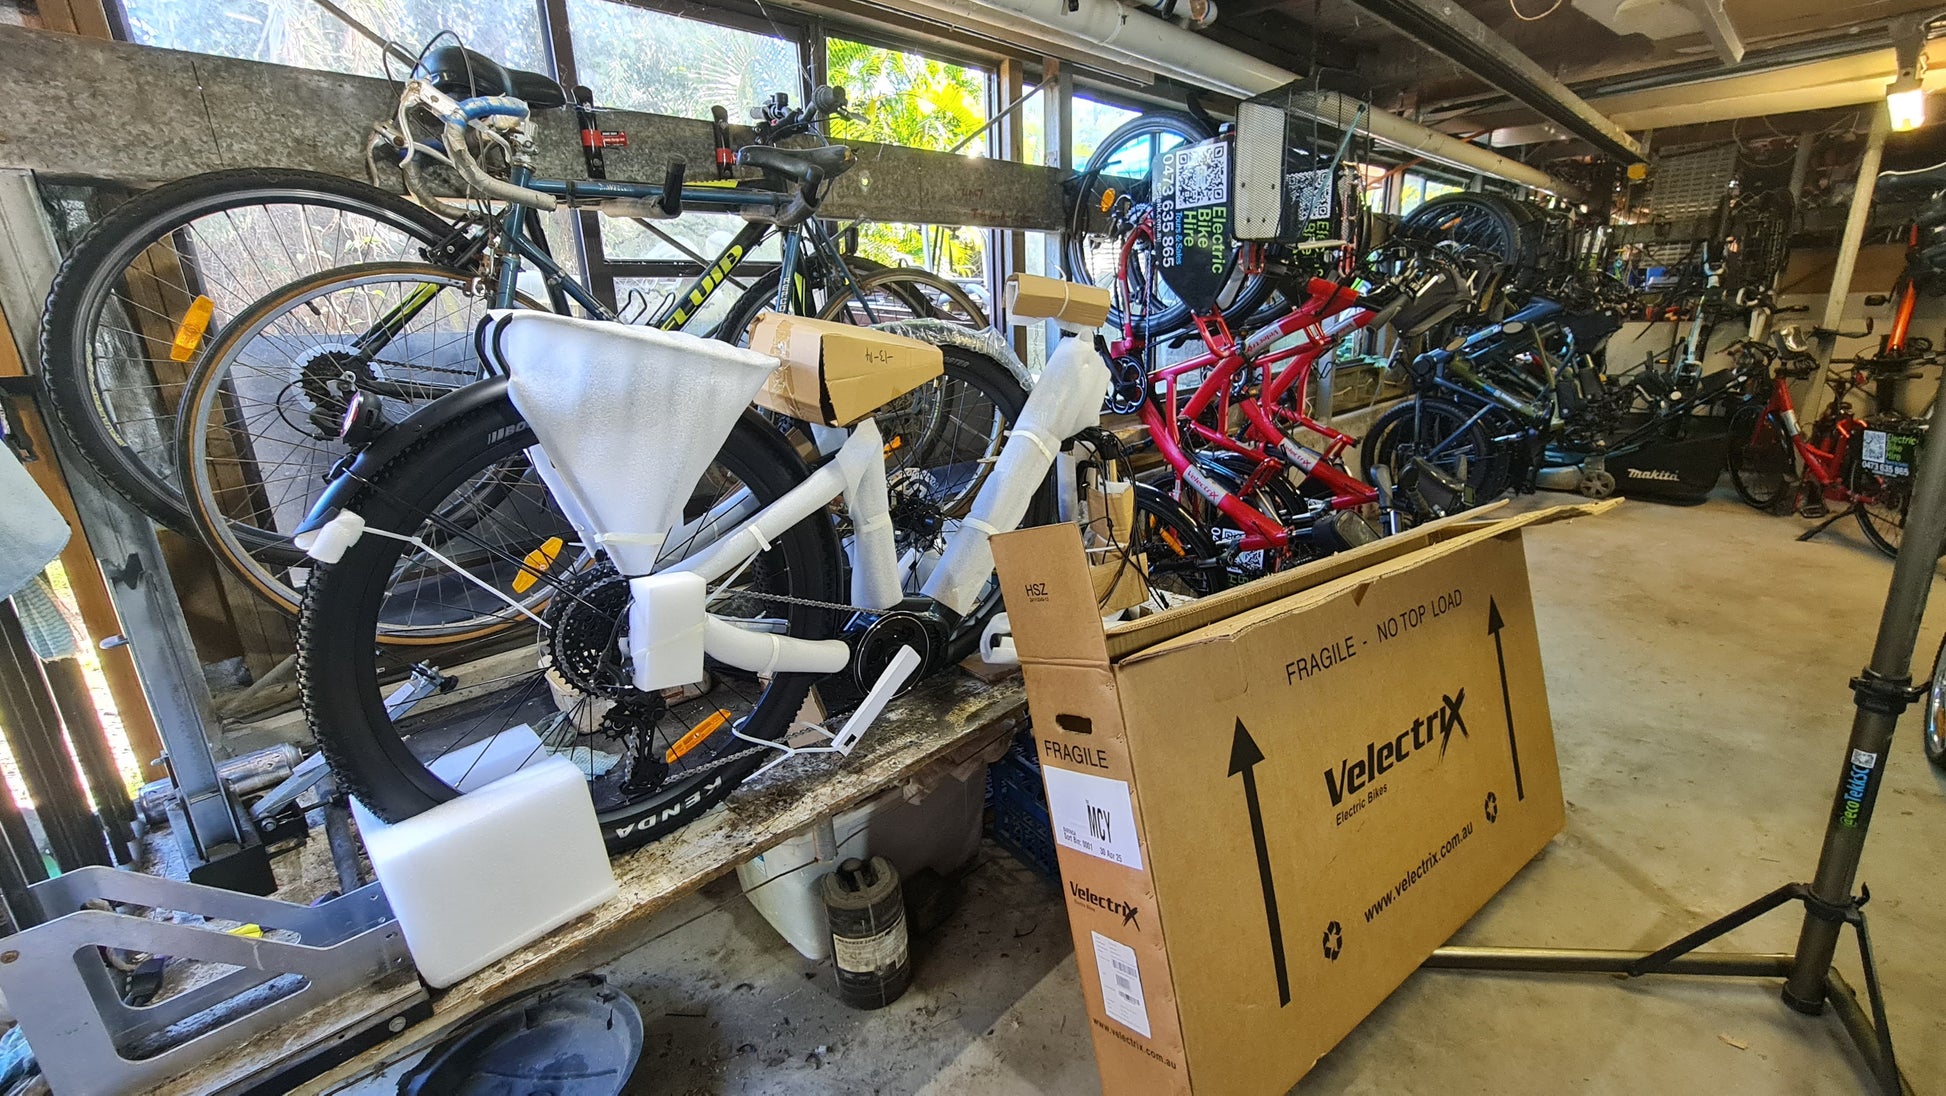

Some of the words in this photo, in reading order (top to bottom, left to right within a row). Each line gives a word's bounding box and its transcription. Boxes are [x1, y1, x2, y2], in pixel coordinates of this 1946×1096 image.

[1162, 153, 1174, 196] 0473
[1162, 200, 1174, 232] 635
[1175, 211, 1183, 233] Tours
[1183, 210, 1197, 247] Hire
[1197, 208, 1212, 248] Bike
[1162, 236, 1175, 268] 865
[1175, 242, 1183, 265] Sales
[1176, 234, 1183, 242] &
[1212, 206, 1227, 274] Electric
[1024, 583, 1049, 597] HSZ
[1285, 636, 1357, 686] FRAGILE
[1376, 617, 1399, 643] NO
[1399, 604, 1426, 632] TOP
[1431, 588, 1463, 618] LOAD
[1043, 739, 1110, 769] FRAGILE
[615, 775, 722, 839] KENDA
[1086, 804, 1112, 844] MCY
[1335, 798, 1366, 827] Electric
[1367, 783, 1388, 805] Bikes
[1363, 820, 1474, 923] www.velectrix.com.au
[1092, 1017, 1177, 1070] www.velectrix.com.au
